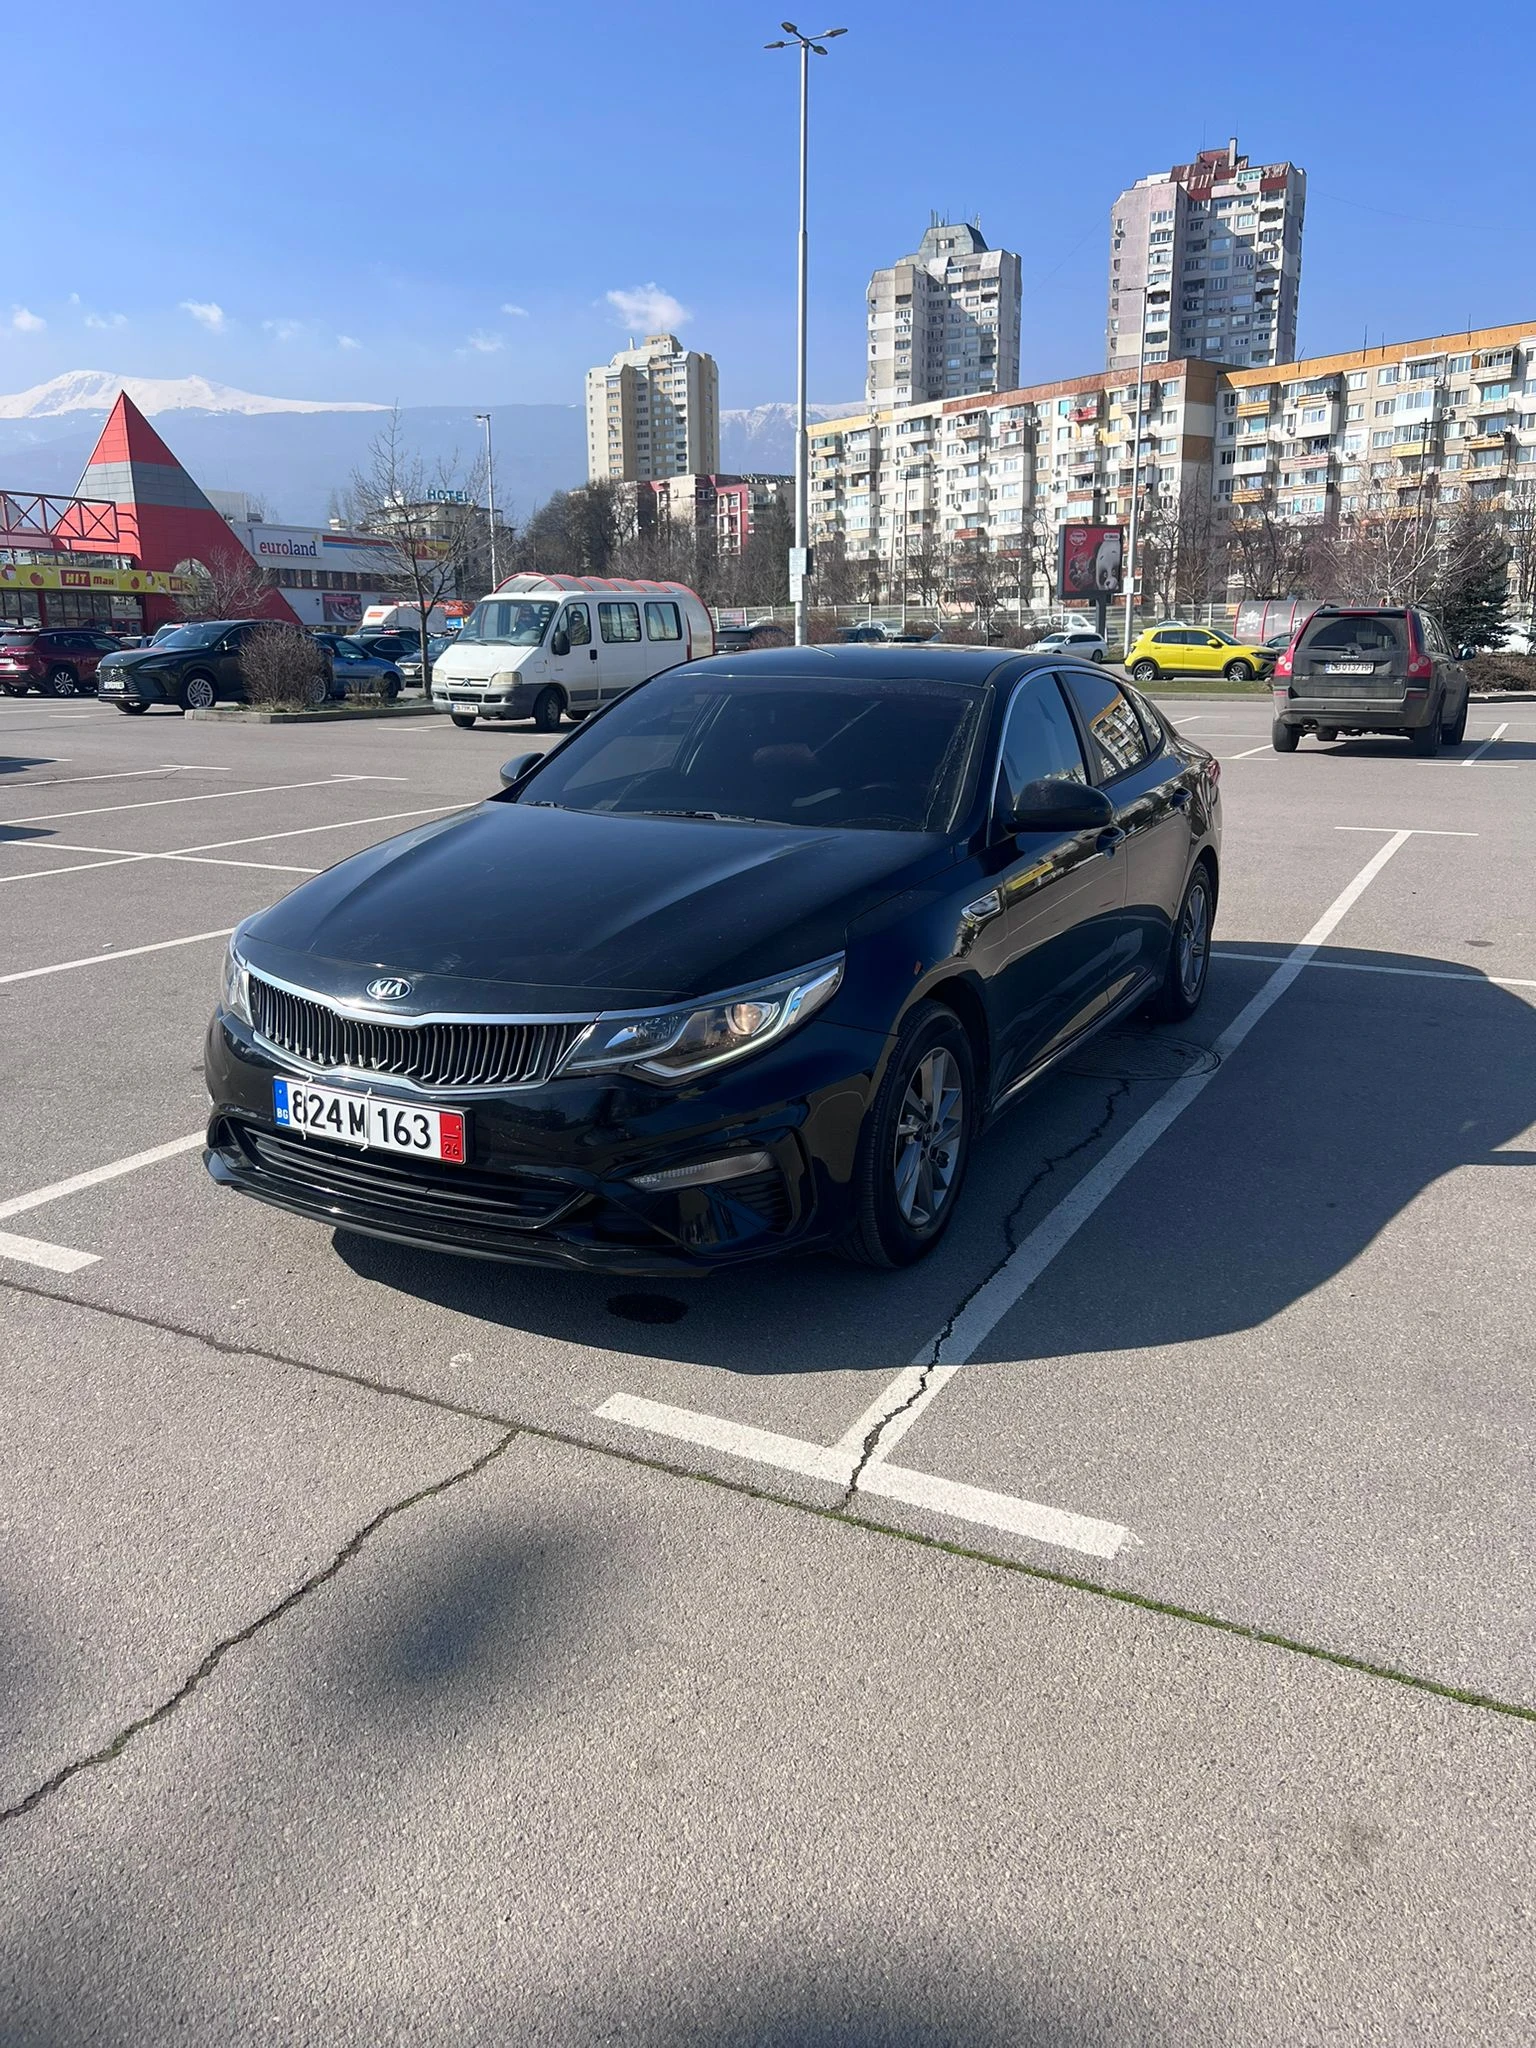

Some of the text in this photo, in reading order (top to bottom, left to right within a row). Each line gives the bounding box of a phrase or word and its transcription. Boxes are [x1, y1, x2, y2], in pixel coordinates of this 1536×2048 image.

[427, 489, 469, 502] HOTEL
[259, 539, 318, 557] euroland
[66, 573, 87, 584] HIT
[371, 980, 403, 996] KIA
[276, 1107, 289, 1120] BG
[292, 1089, 432, 1150] 824 M 163
[444, 1143, 459, 1157] 26
